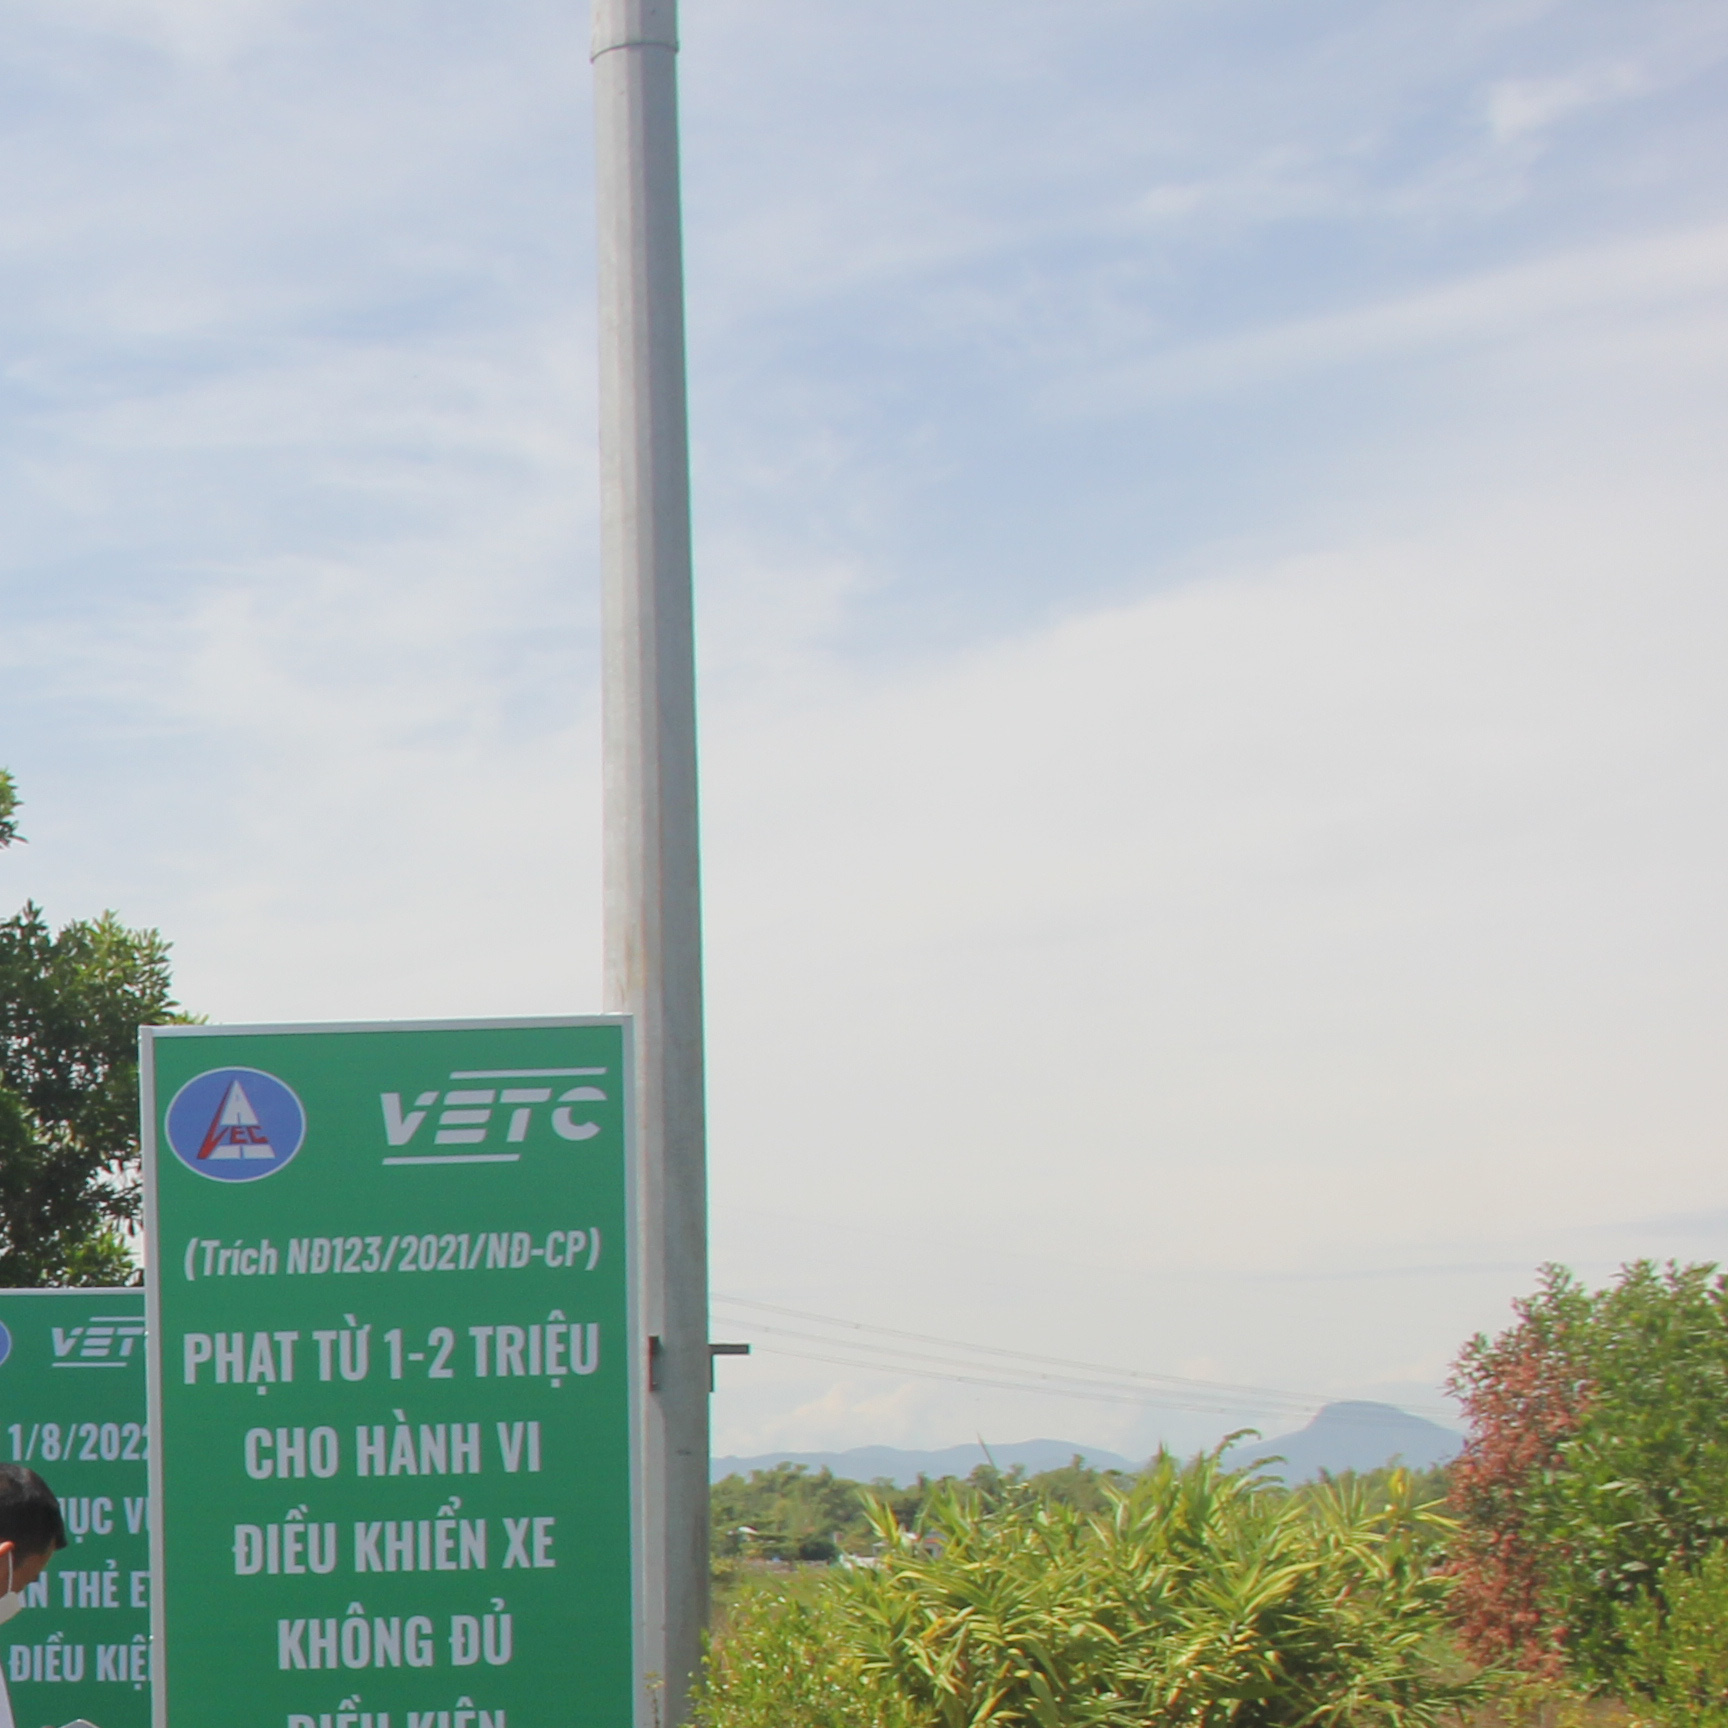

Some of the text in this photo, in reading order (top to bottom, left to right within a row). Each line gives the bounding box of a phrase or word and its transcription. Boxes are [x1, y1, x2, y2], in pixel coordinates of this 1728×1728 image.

[380, 1086, 608, 1146] VETC
[184, 1237, 278, 1281] (Trích
[183, 1309, 600, 1395] PHẠT TỪ 1-2 TRIỆU
[245, 1409, 542, 1480] CHO HÀNH VI
[233, 1496, 556, 1576] ĐIỀU KHIỂN XE
[59, 1559, 120, 1608] THẺ
[8, 1631, 152, 1690] ĐIỀU KIỆ
[277, 1598, 513, 1671] KHÔNG ĐỦ
